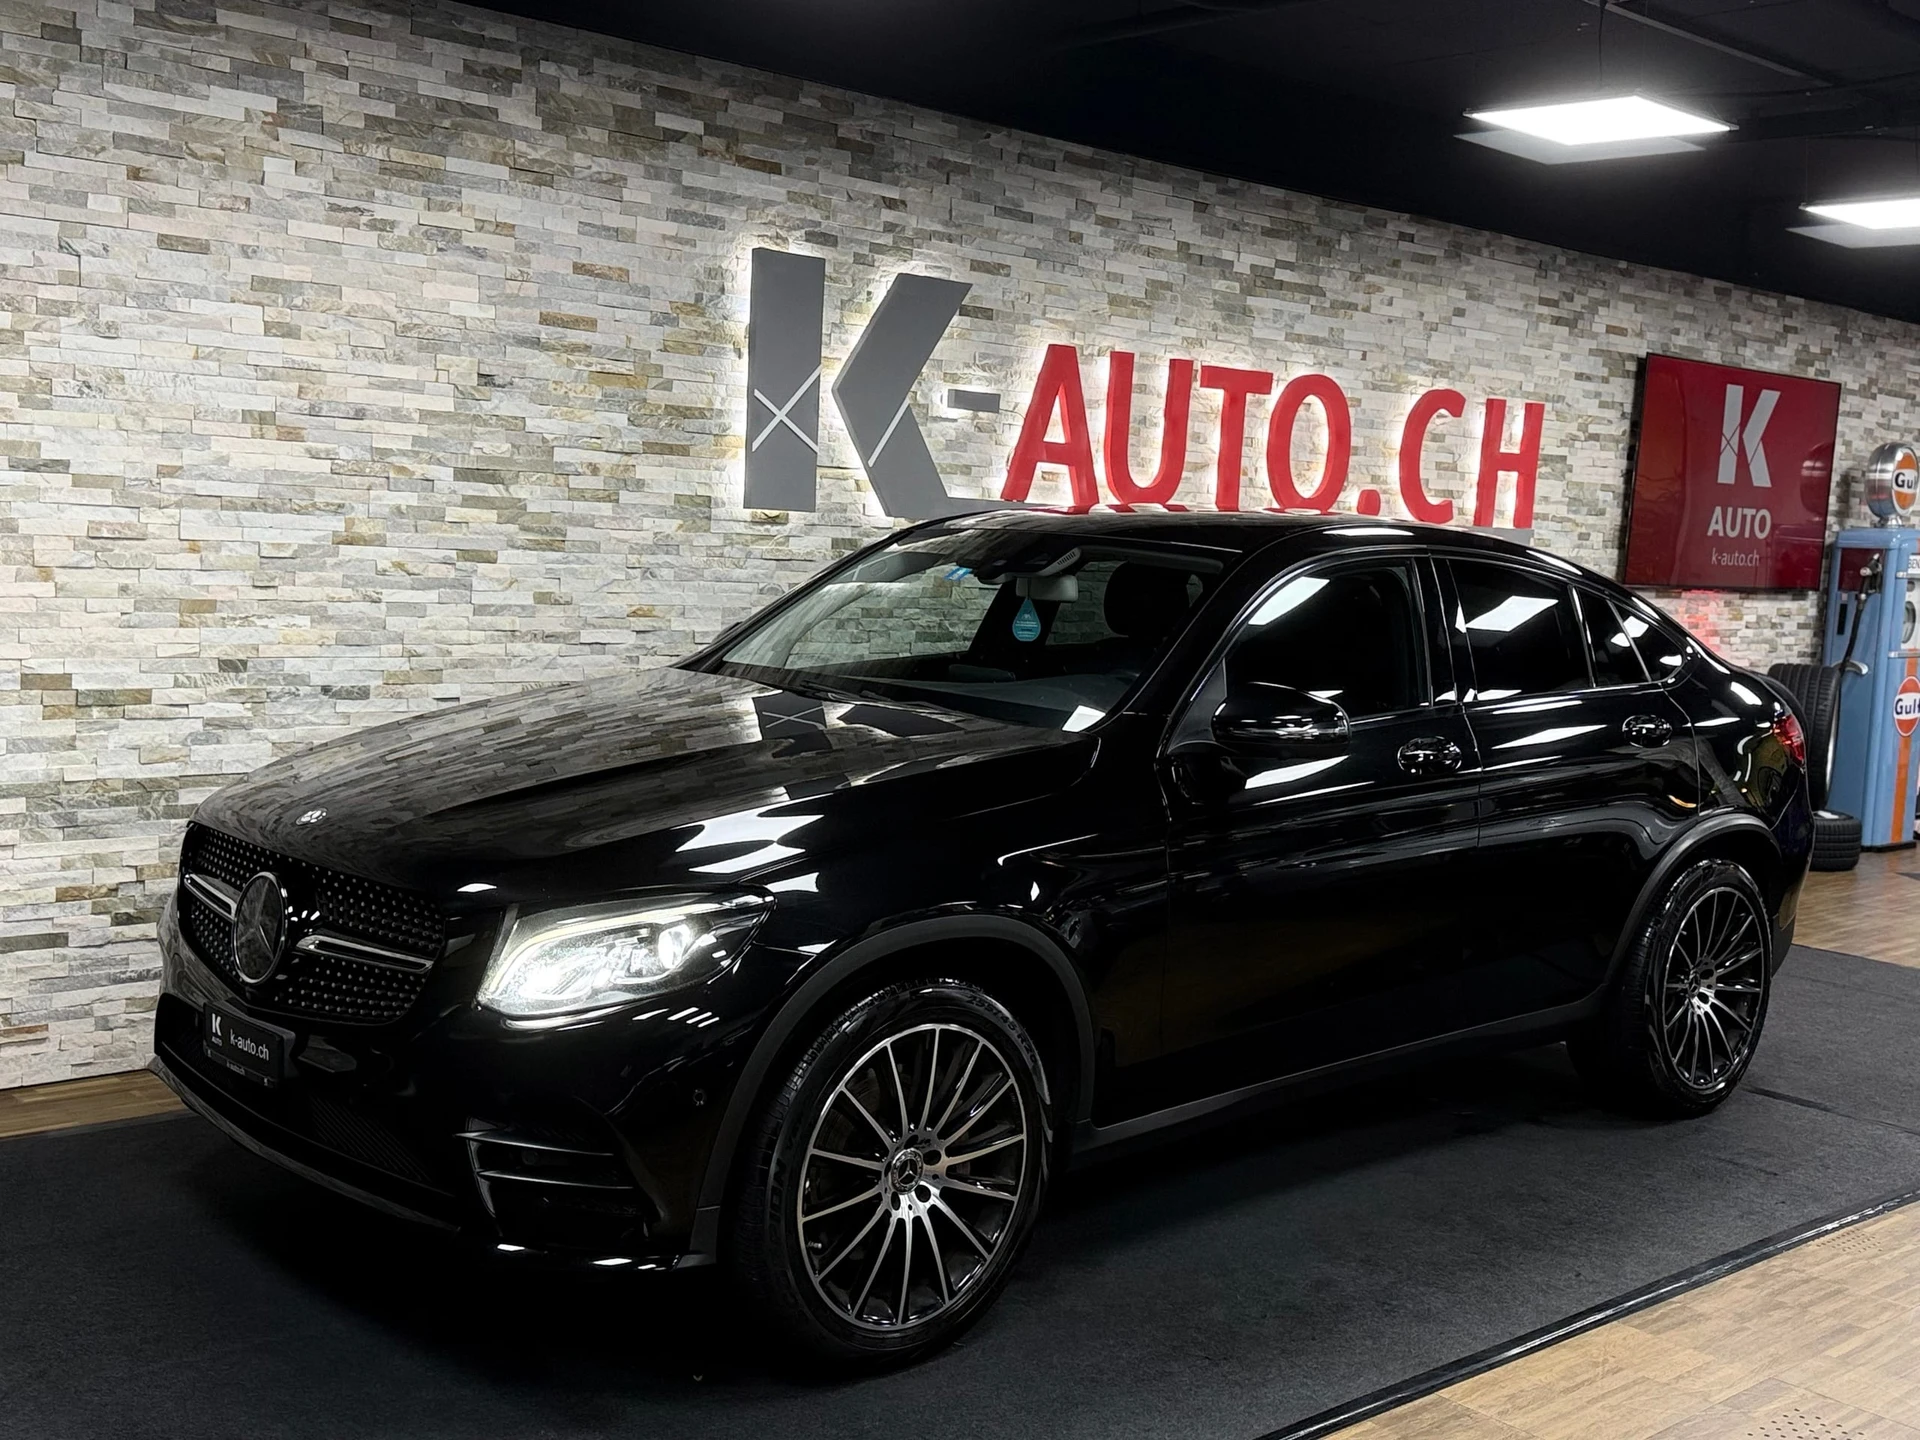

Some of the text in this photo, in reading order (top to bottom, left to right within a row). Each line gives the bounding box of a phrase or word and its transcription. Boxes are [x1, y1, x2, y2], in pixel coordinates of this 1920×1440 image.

[1717, 383, 1781, 488] K
[1706, 505, 1772, 539] AUTO
[1711, 547, 1760, 567] k-auto.ch
[211, 1012, 222, 1037] K
[229, 1028, 270, 1062] k-auto.ch
